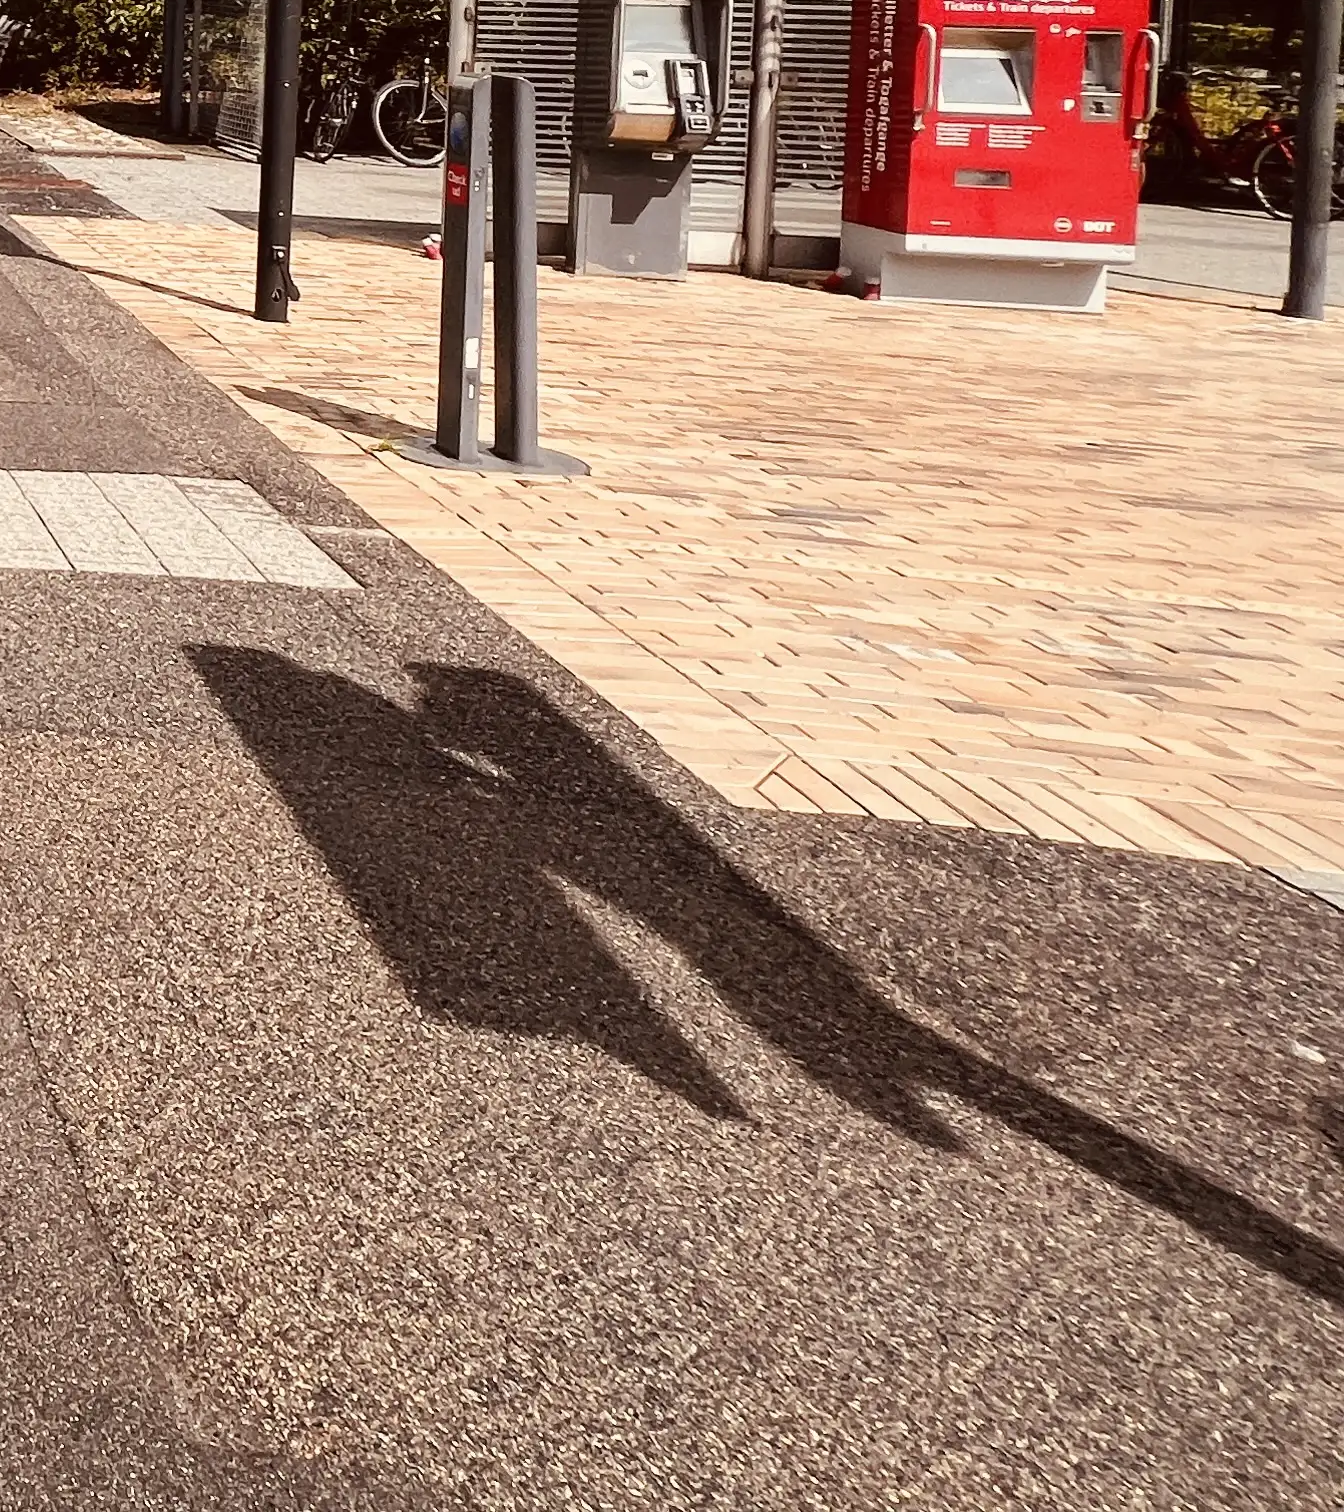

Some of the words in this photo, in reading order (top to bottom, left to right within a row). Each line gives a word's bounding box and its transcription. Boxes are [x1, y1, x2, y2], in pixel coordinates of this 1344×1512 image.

[943, 1, 985, 12] Tickets
[986, 2, 997, 12] &
[1000, 2, 1029, 13] Train
[868, 48, 880, 60] &
[881, 59, 894, 72] &
[866, 66, 880, 103] Train
[875, 76, 893, 172] Togafgange
[861, 107, 877, 192] departures
